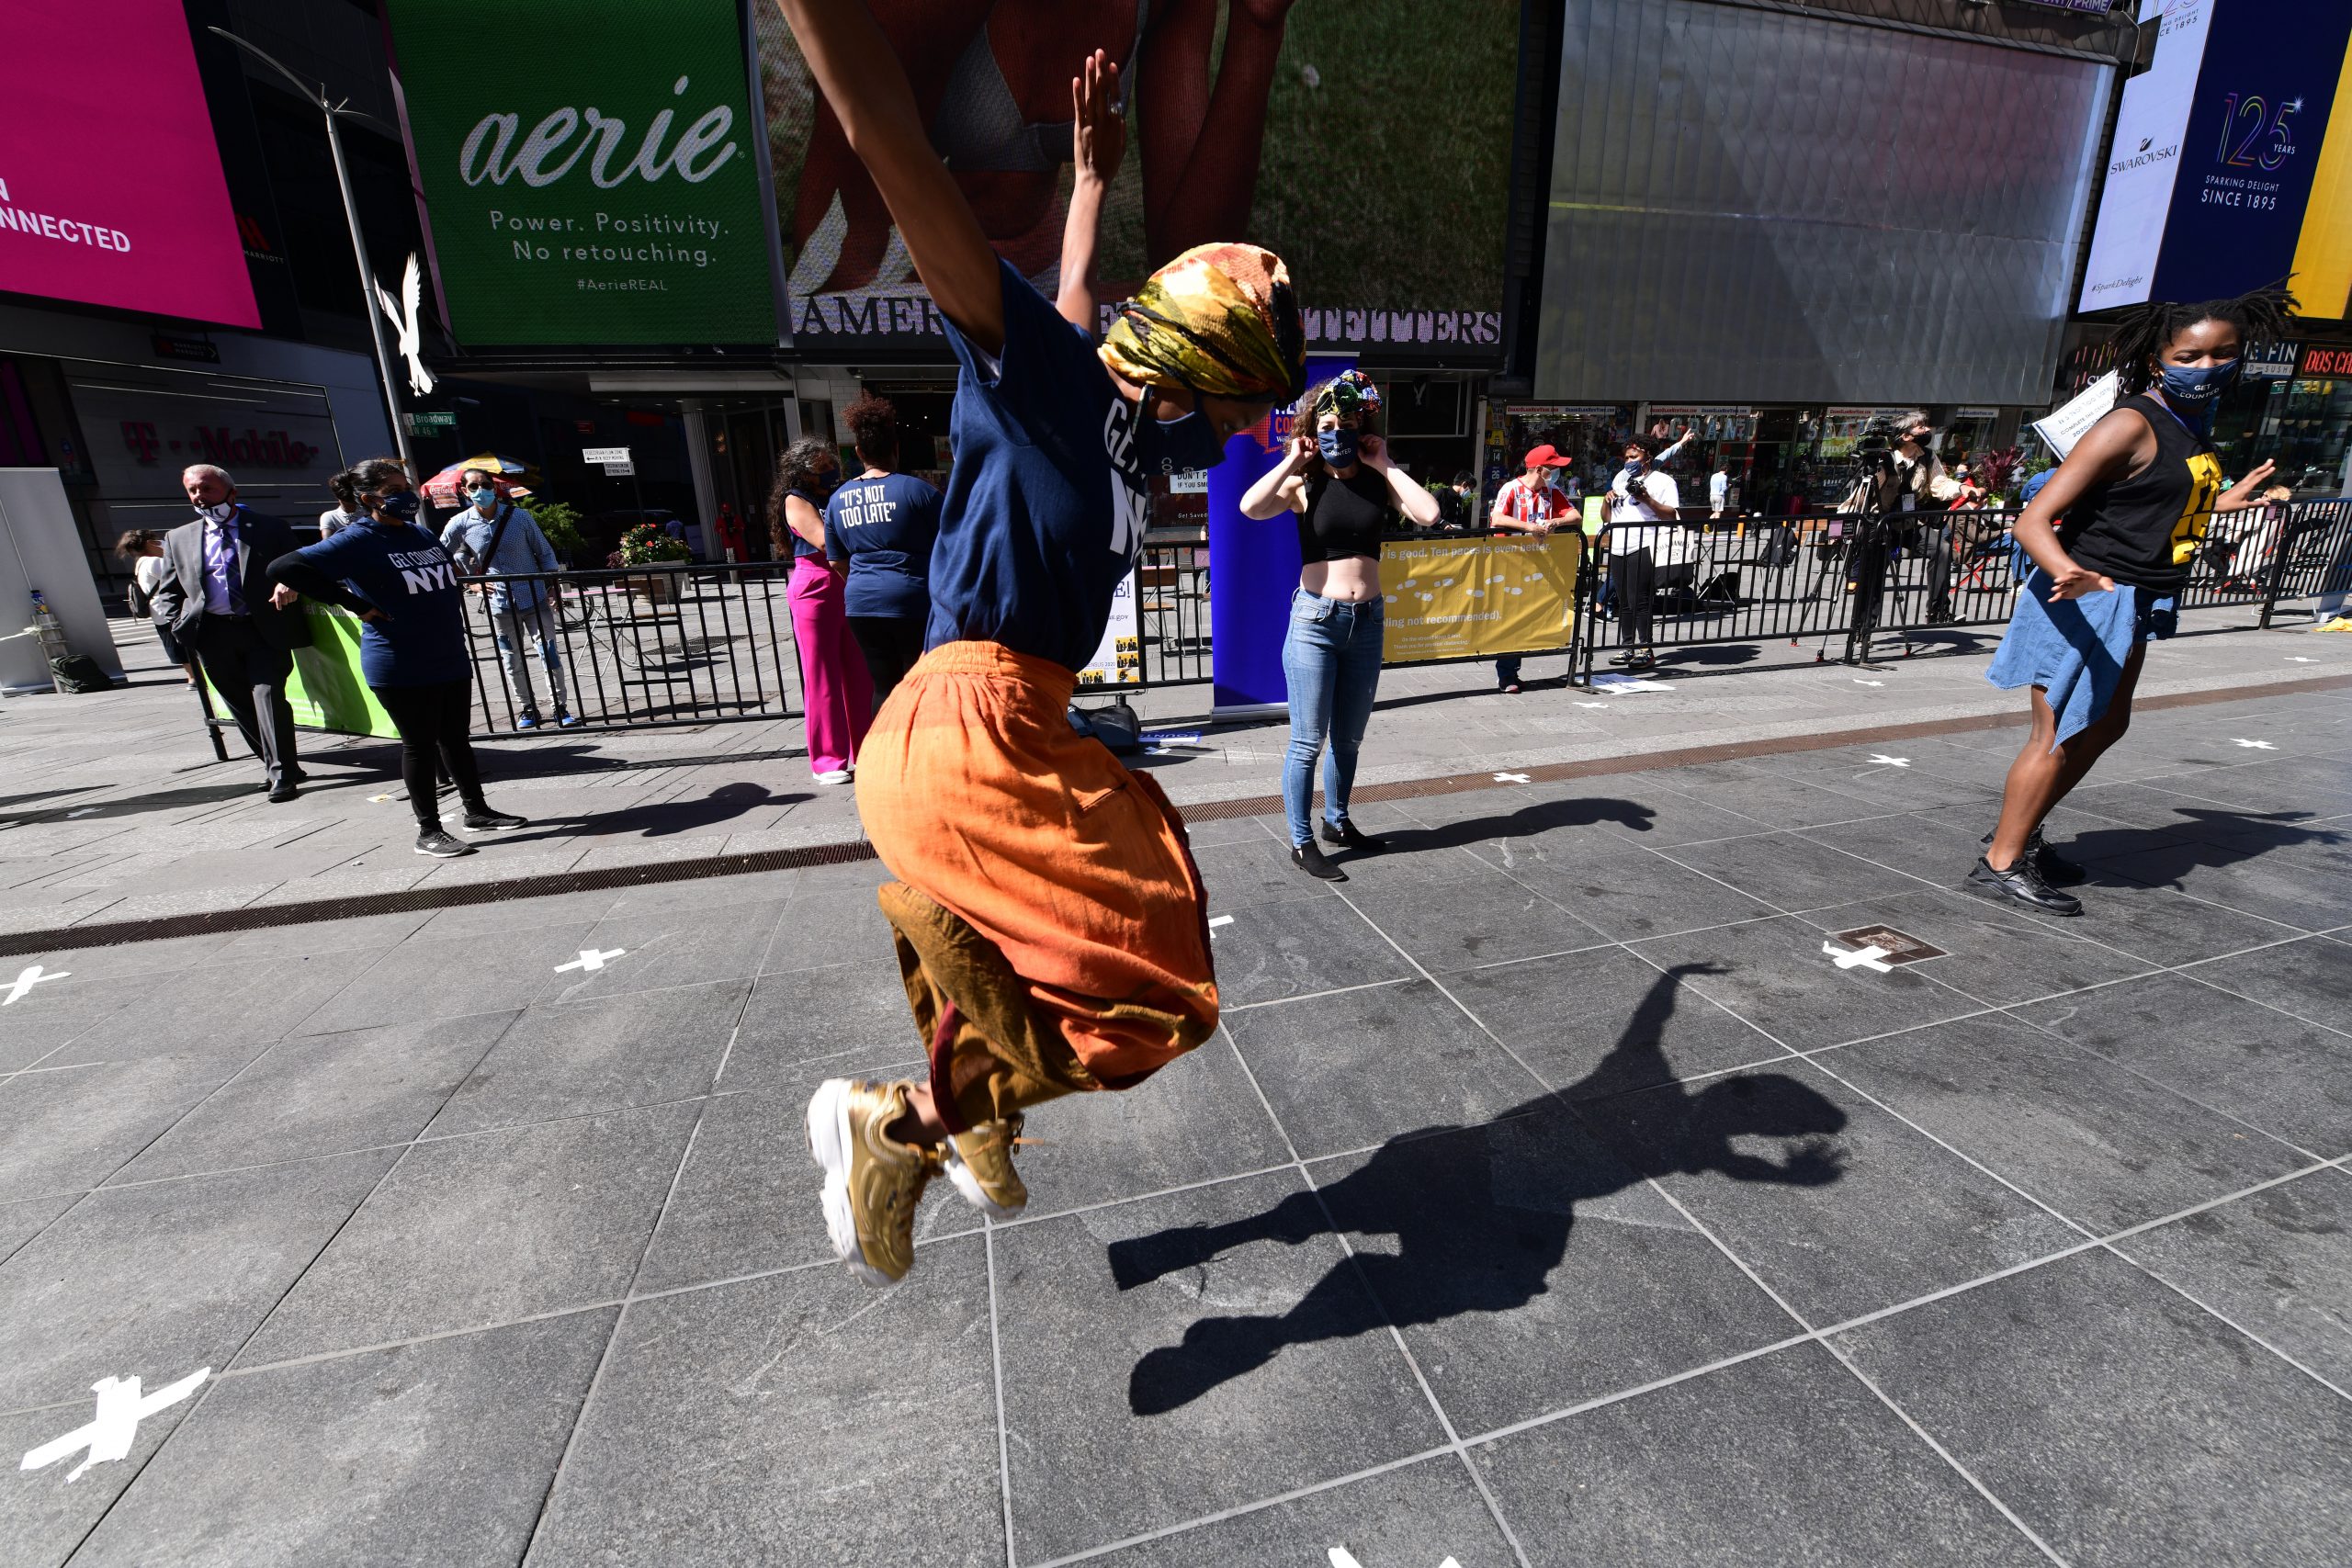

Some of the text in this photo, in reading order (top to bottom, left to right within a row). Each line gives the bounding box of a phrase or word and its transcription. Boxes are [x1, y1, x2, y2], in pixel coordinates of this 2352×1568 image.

[2175, 8, 2199, 22] DELIGHT
[2175, 17, 2199, 31] 1895
[460, 75, 737, 188] aerie
[2216, 92, 2297, 171] 125
[2274, 143, 2295, 155] YEARS
[2109, 144, 2177, 175] SWAROVSKI
[2205, 175, 2279, 193] SPARKING DELIGHT
[2201, 189, 2277, 211] SINCE 1895
[490, 210, 729, 239] Power. Positivity.
[513, 240, 717, 267] No retouching.
[577, 278, 669, 291] #AerieREAL
[2091, 276, 2143, 294] #SparkDelight
[799, 295, 1499, 344] AMER TFITTERS
[2304, 350, 2335, 374] DOS
[2179, 387, 2220, 400] COUNTED
[2194, 383, 2211, 391] GET
[415, 413, 452, 424] Broadway
[413, 425, 420, 434] W
[423, 426, 432, 435] 46
[1329, 447, 1351, 457] COUNTED
[1491, 469, 1500, 479] 26
[865, 485, 885, 502] NOT
[840, 505, 863, 529] TOO
[387, 553, 414, 568] GET
[1386, 549, 1397, 559] is
[1399, 549, 1428, 561] good.
[1430, 547, 1449, 557] Ten
[1451, 547, 1481, 558] paces
[1482, 545, 1492, 553] is
[1494, 545, 1519, 553] even
[1114, 581, 1131, 598] E!
[1384, 610, 1502, 629] ling not recommended).
